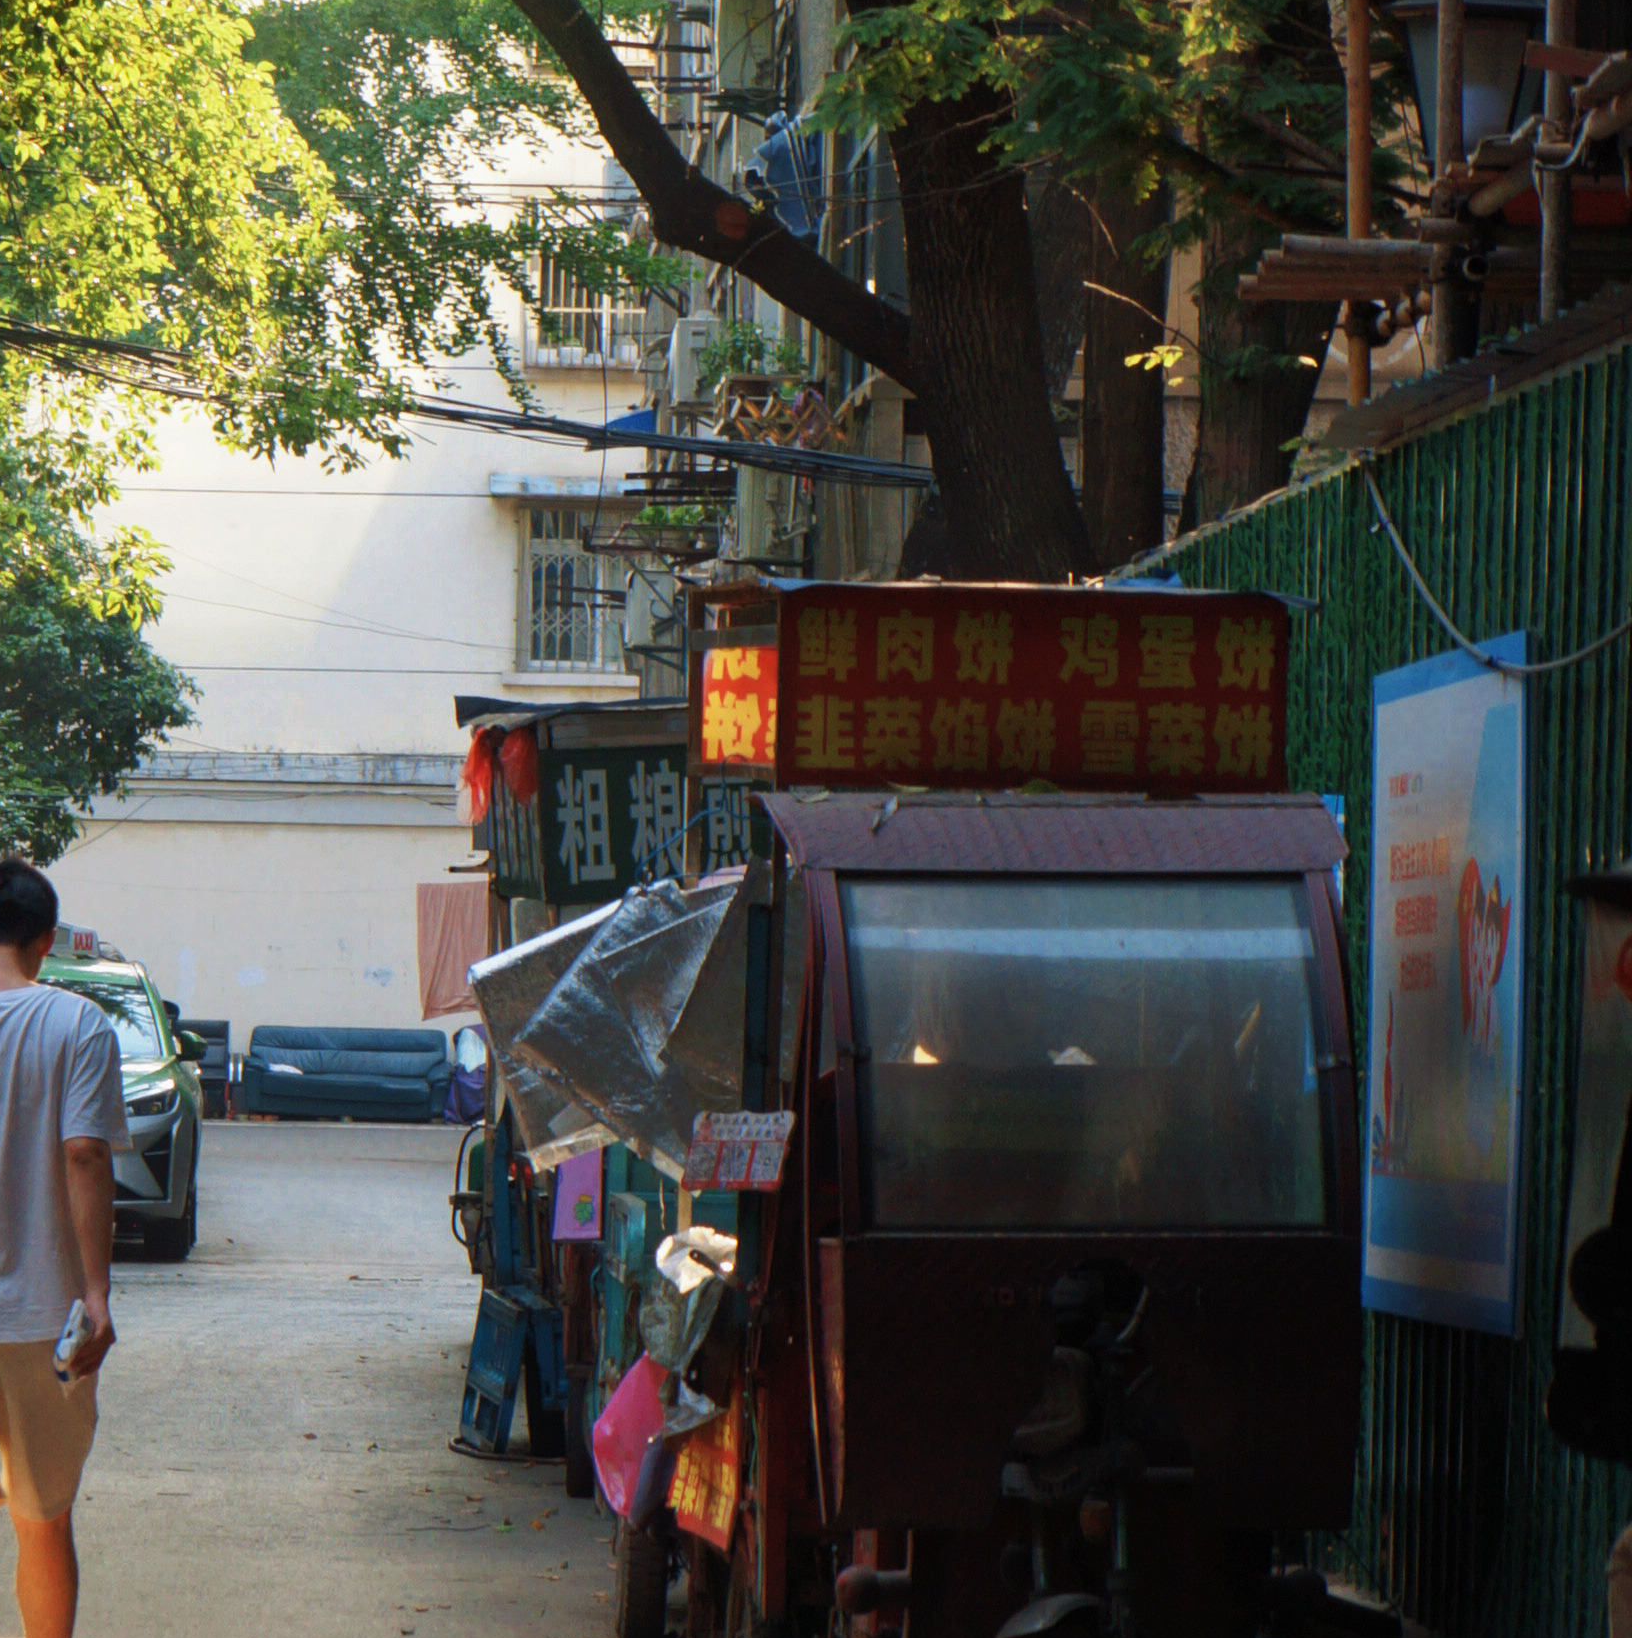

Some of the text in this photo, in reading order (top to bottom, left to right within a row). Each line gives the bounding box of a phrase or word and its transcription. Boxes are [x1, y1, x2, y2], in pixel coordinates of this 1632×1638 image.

[798, 606, 1014, 685] 鲜肉饼
[1058, 613, 1276, 692] 鸡蛋饼
[795, 693, 1273, 778] 韭菜馅饼 雪菜饼
